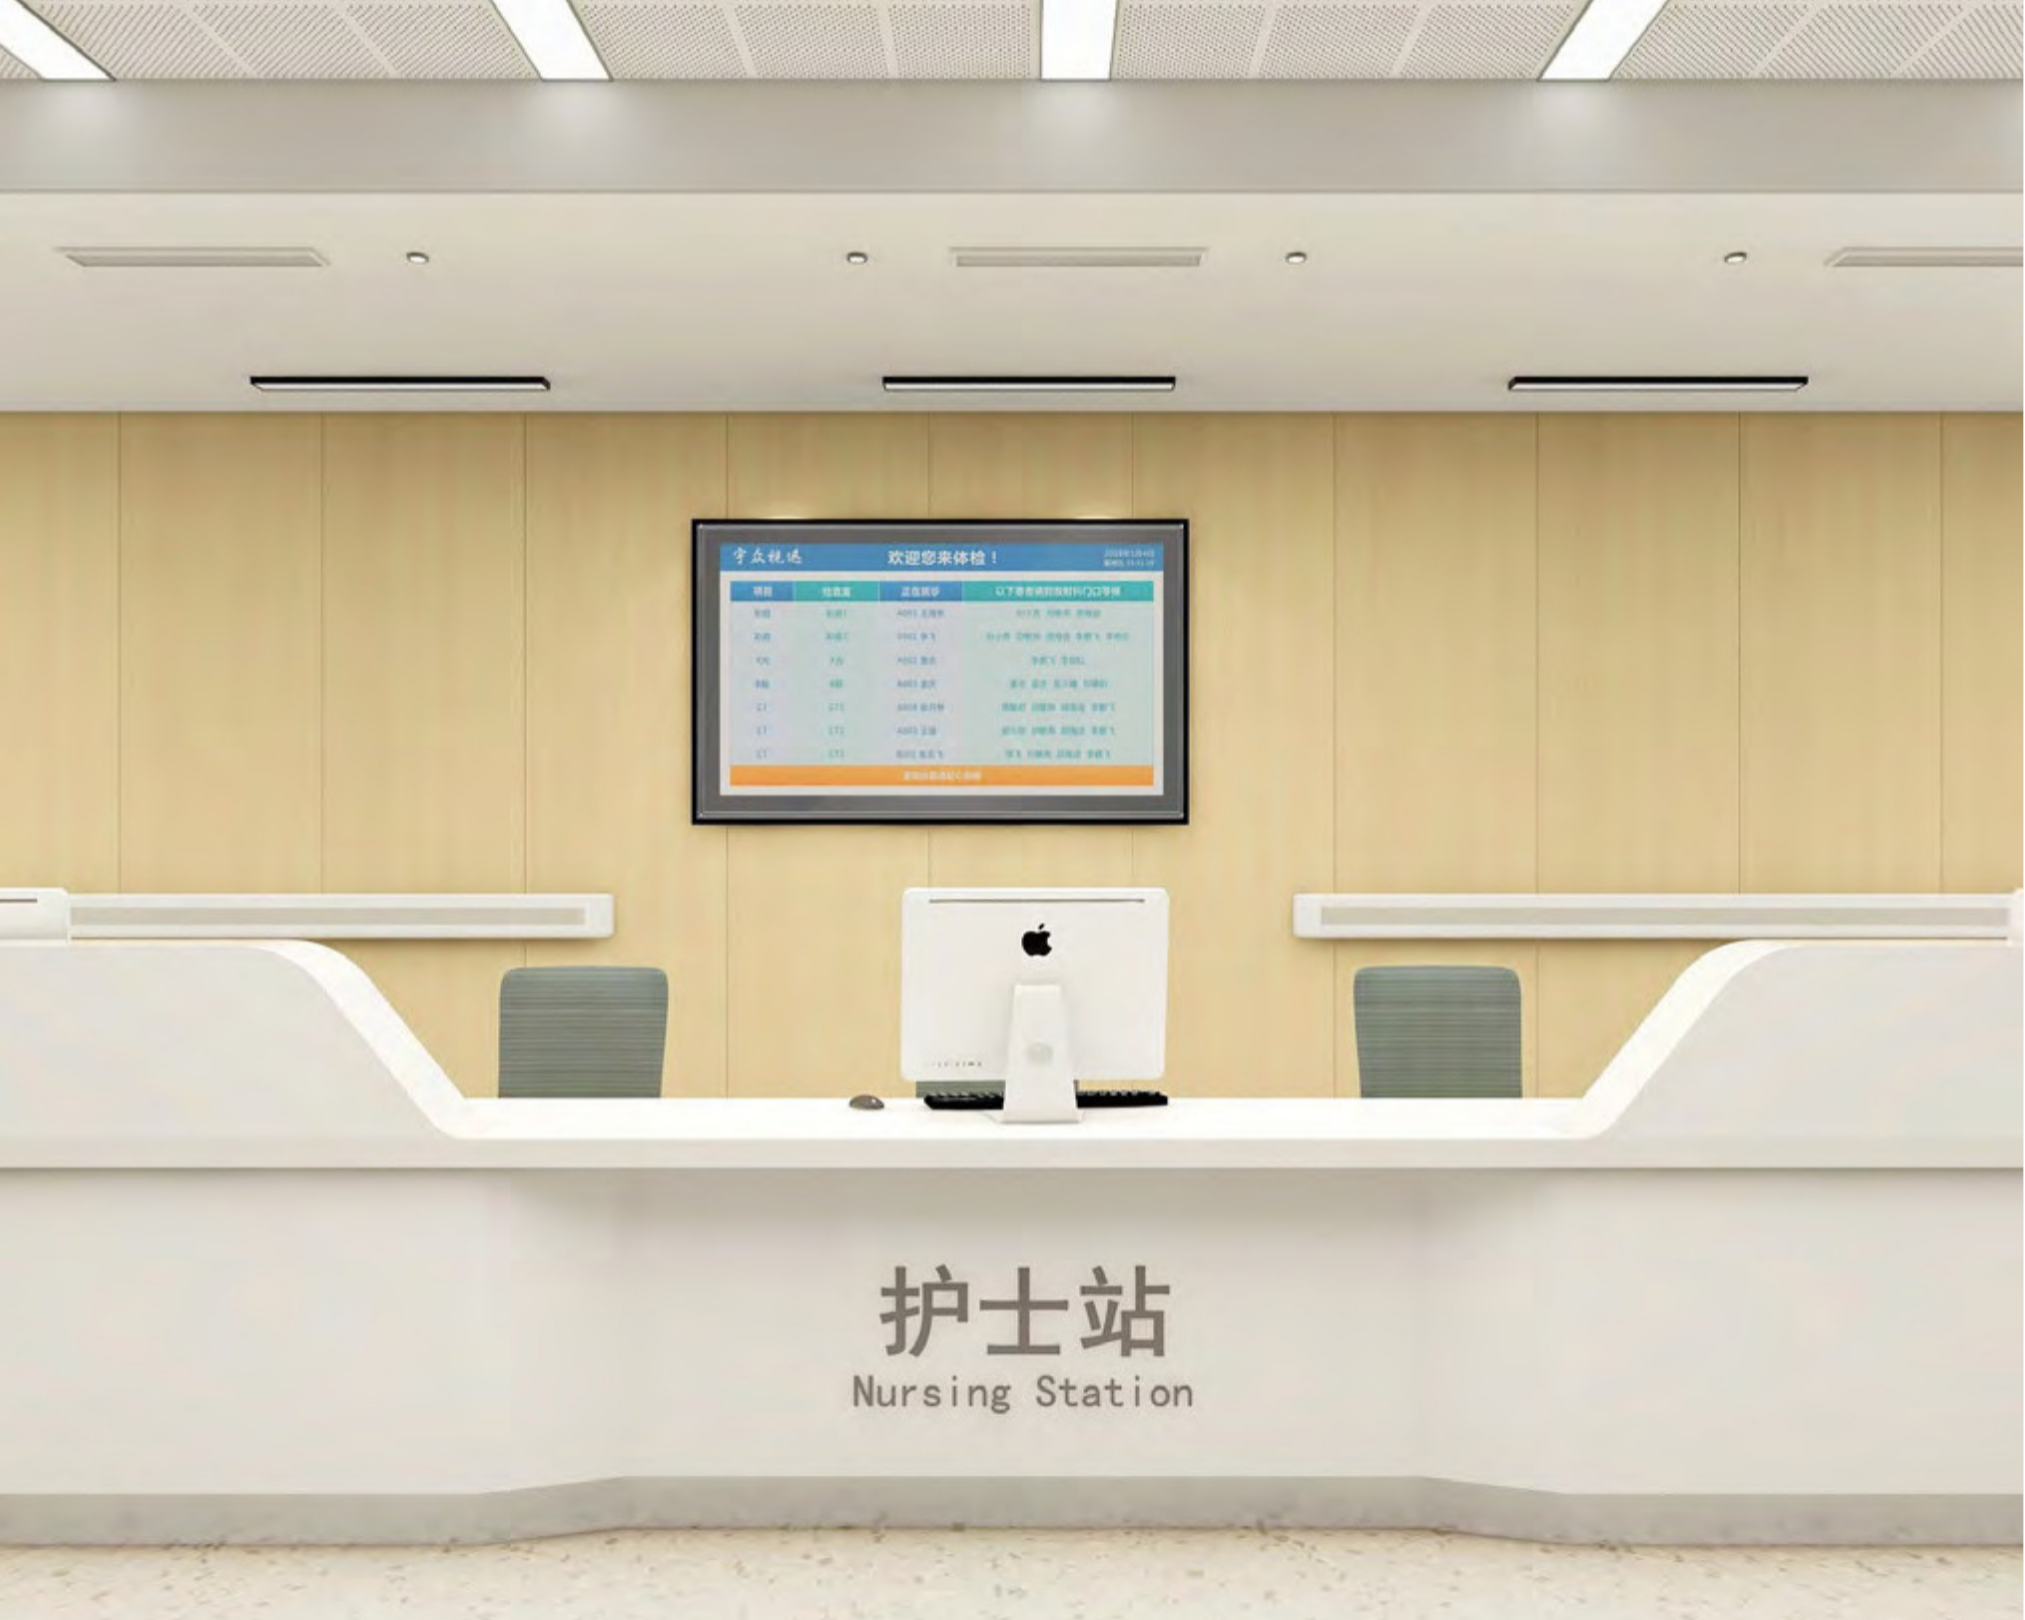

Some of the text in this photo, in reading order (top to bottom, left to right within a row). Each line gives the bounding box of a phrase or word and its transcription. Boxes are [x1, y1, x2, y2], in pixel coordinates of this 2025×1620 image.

[879, 1264, 1171, 1357] 护士站
[853, 1375, 1194, 1414] Nursing Station
